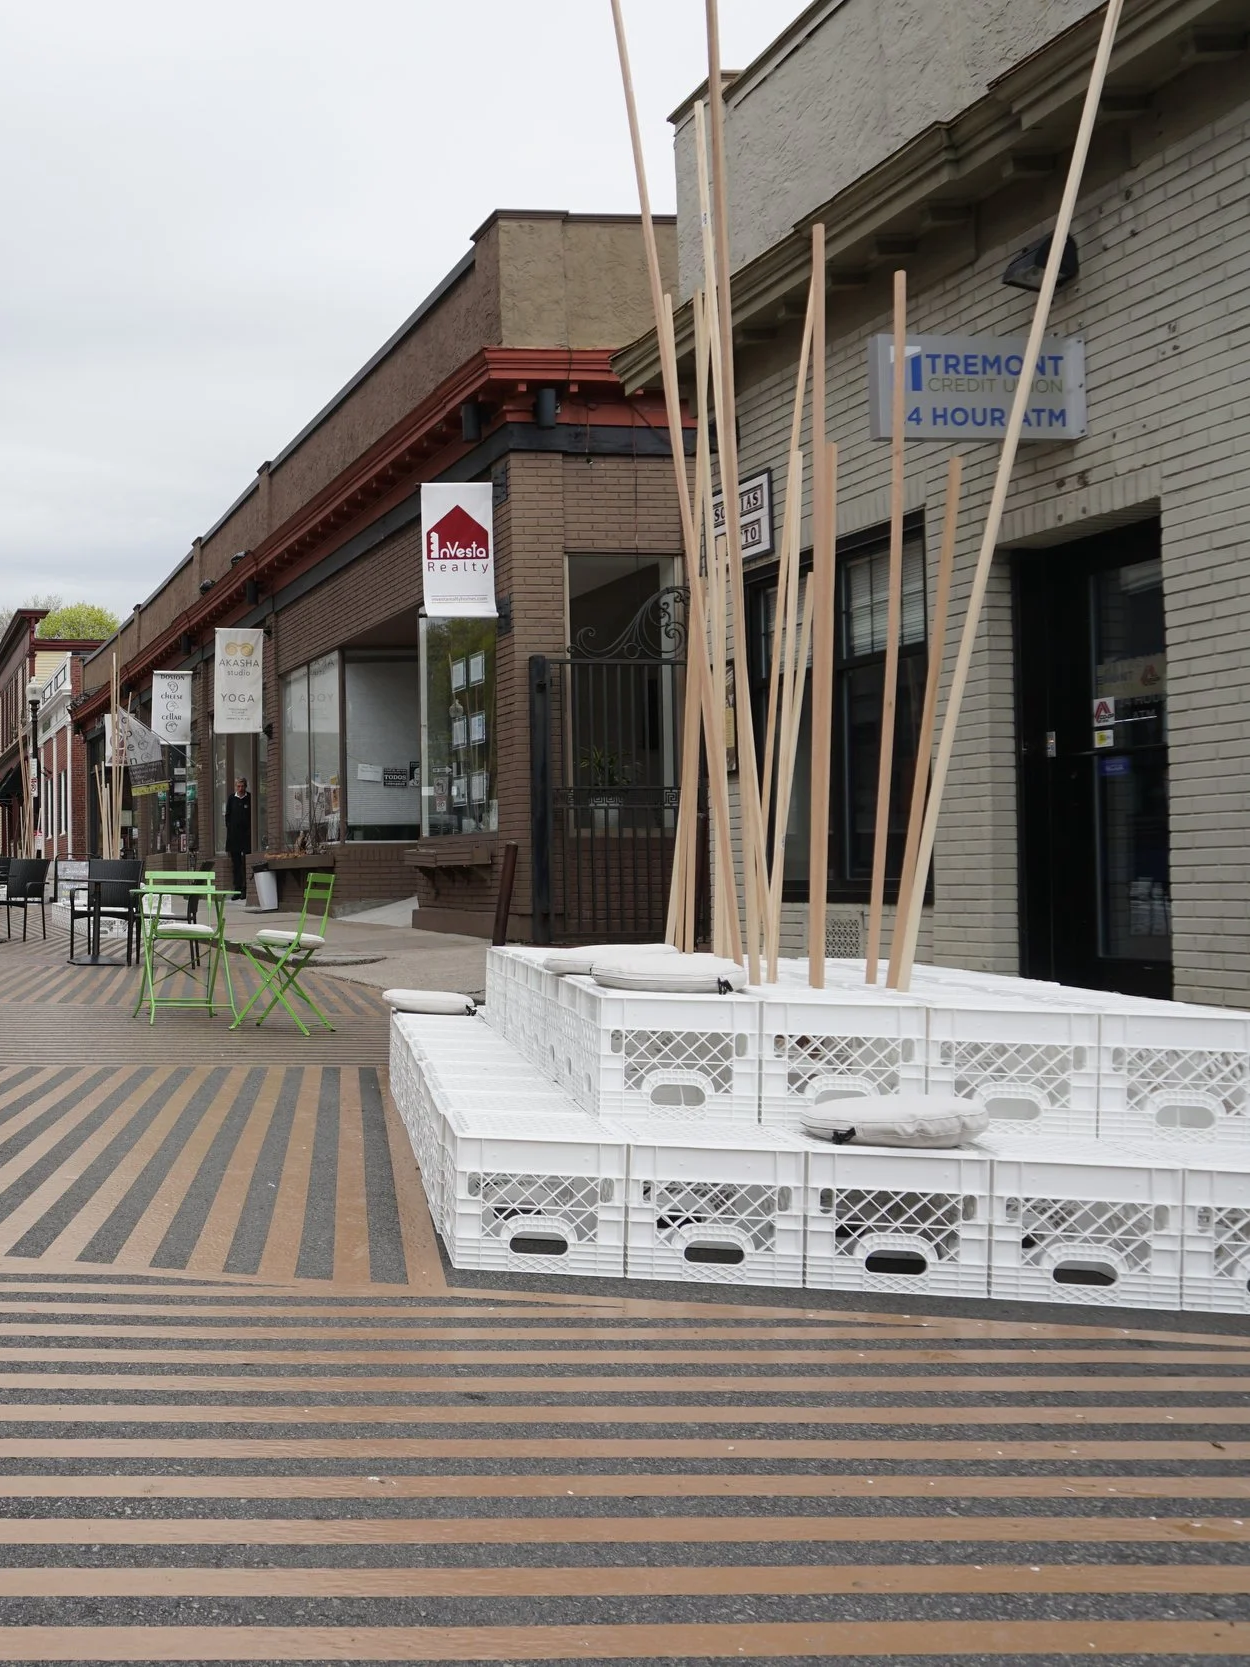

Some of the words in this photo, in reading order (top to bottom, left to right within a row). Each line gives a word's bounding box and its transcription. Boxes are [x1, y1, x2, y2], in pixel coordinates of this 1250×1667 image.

[925, 353, 1064, 377] TREMONT
[927, 377, 997, 393] CREDIT
[1003, 378, 1063, 394] UION
[904, 406, 923, 426] 4
[932, 406, 1006, 427] HOUR
[1022, 408, 1067, 428] ATM
[427, 561, 489, 574] Realty
[219, 658, 260, 668] AKASHA
[221, 693, 255, 703] YOGA
